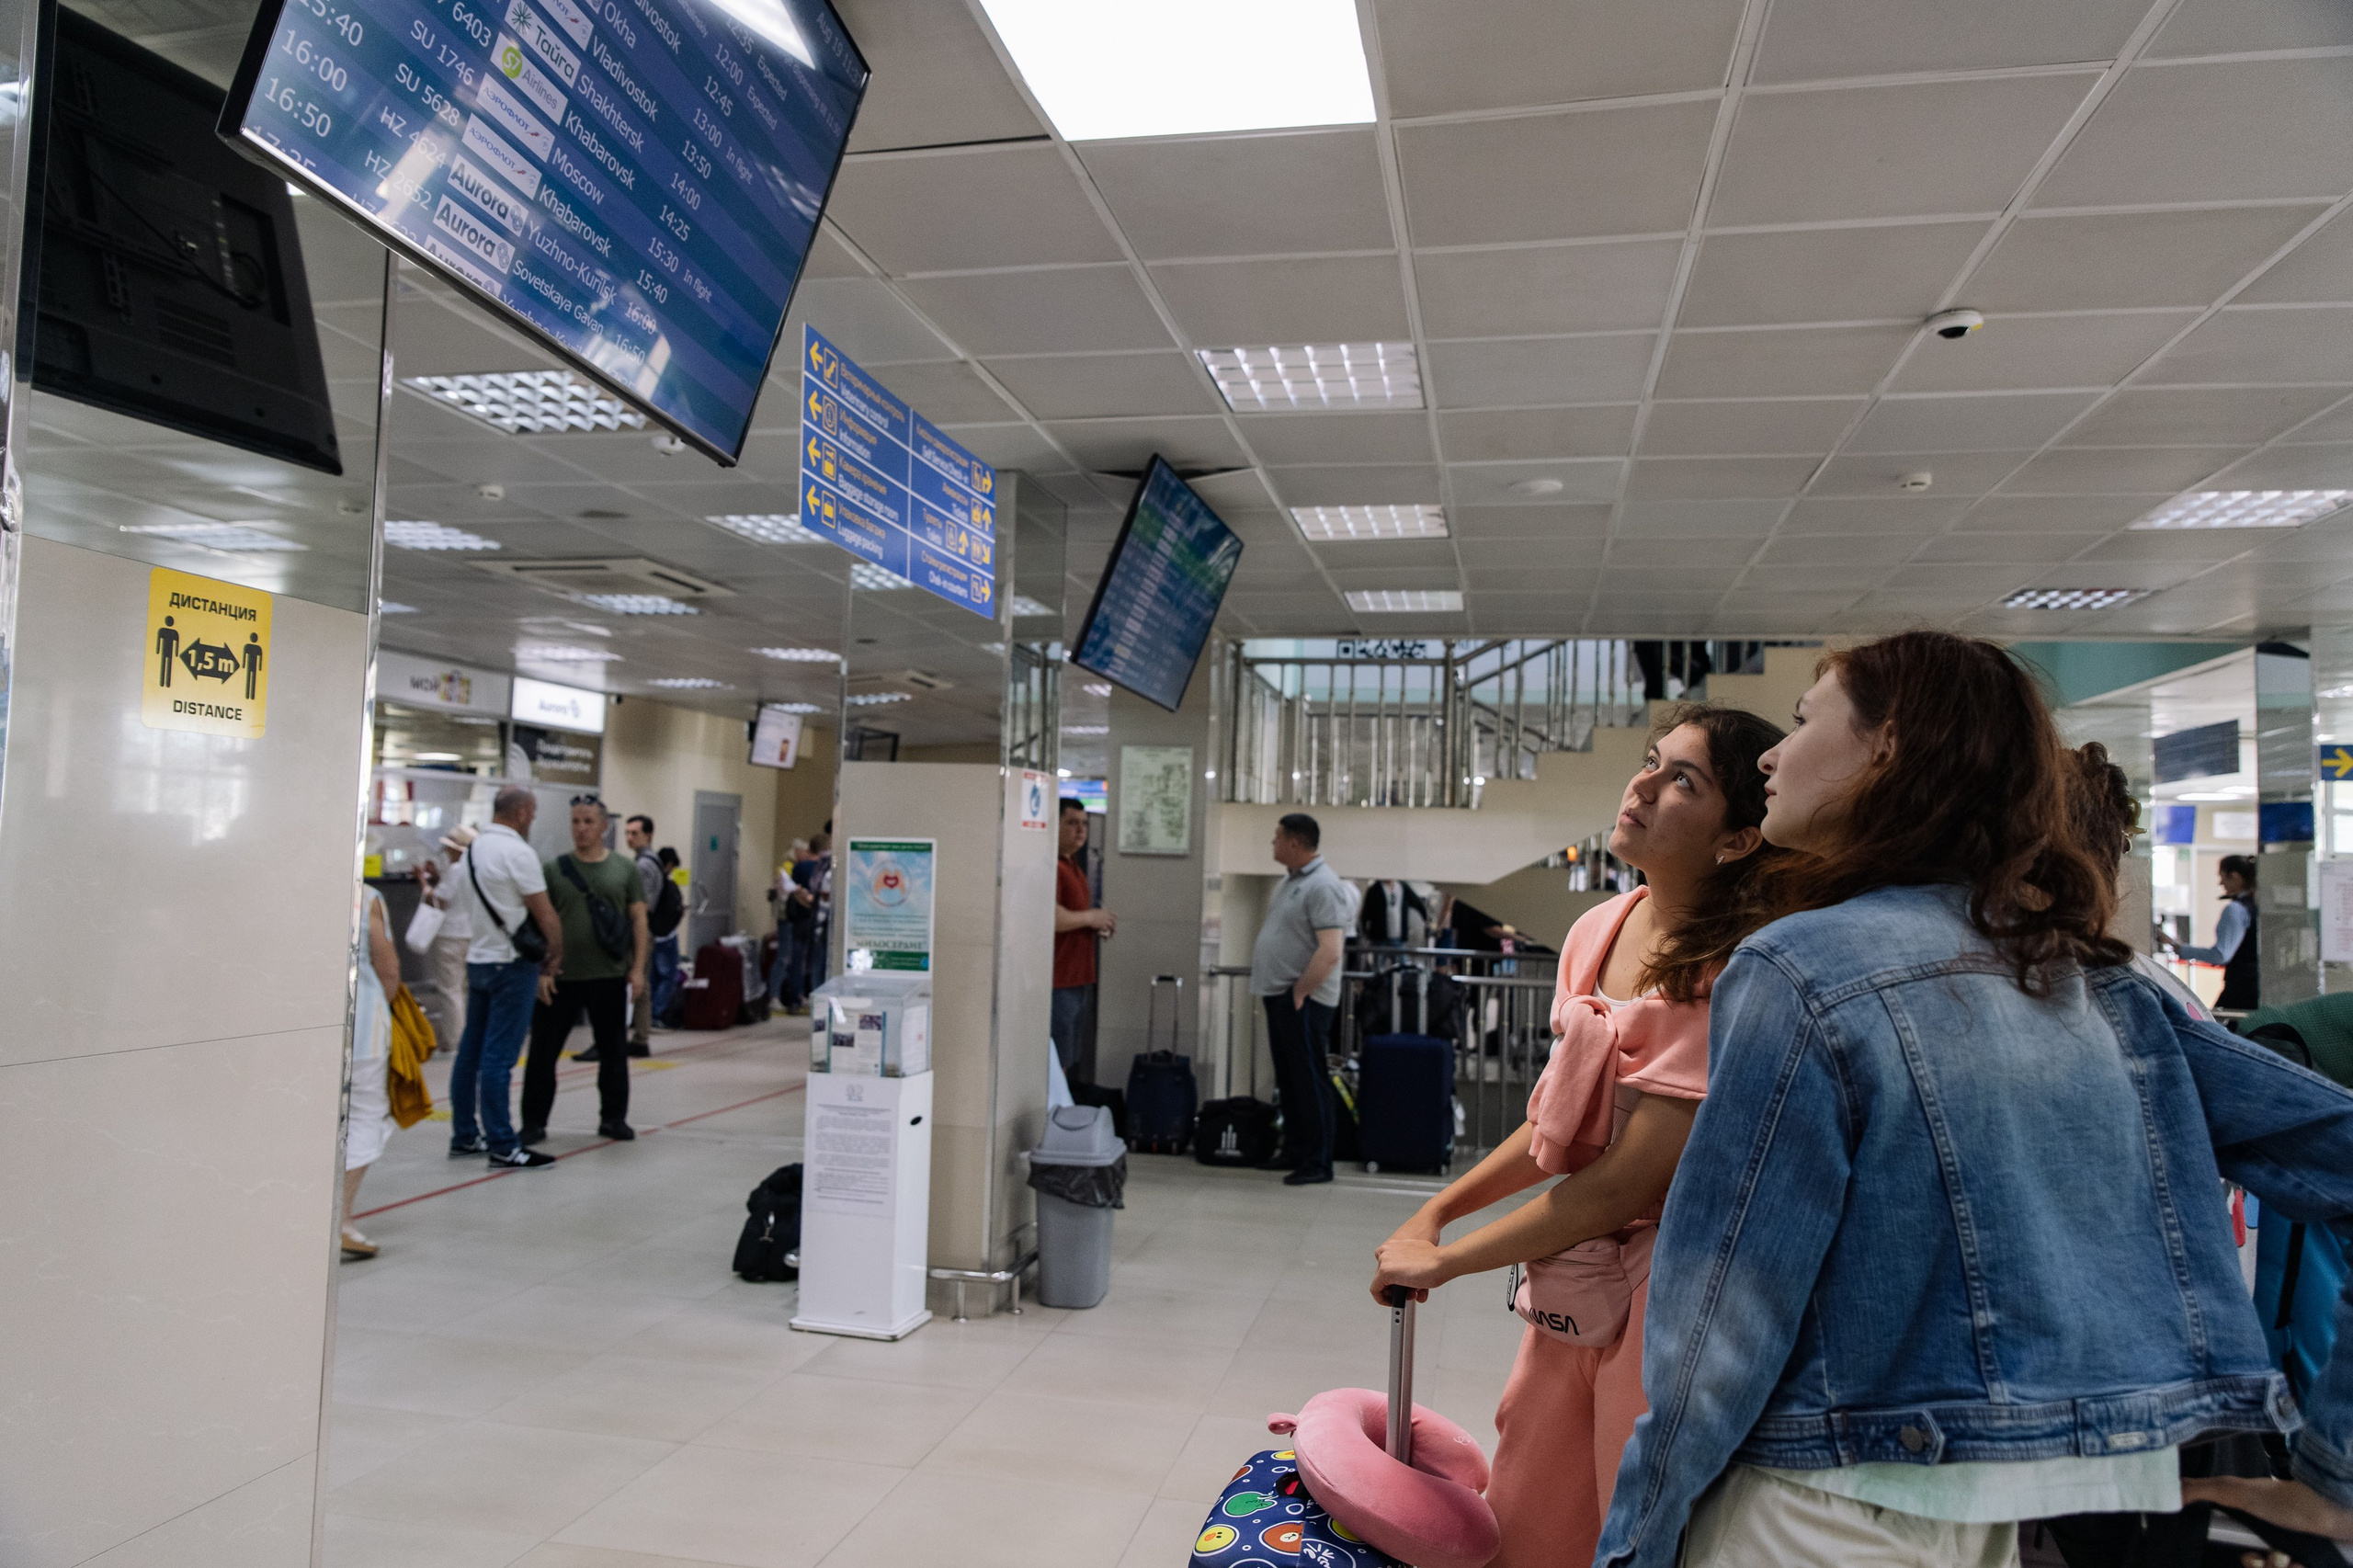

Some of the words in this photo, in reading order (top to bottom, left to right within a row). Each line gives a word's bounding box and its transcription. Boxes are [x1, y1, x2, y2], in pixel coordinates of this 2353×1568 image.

[300, 0, 363, 46] 5:40
[452, 2, 492, 48] 6403
[604, 2, 636, 49] Okha
[281, 28, 347, 92] 16:00
[410, 19, 436, 49] SU
[437, 44, 475, 85] 1746
[715, 43, 744, 85] 12:00
[395, 63, 420, 92] SU
[422, 85, 460, 126] 5628
[503, 51, 521, 72] S7
[522, 69, 558, 109] Airlines
[592, 35, 659, 122] Vladivostok
[704, 75, 733, 118] 12:45
[757, 55, 788, 101] Expected
[265, 77, 331, 137] 16:50
[483, 86, 530, 131] АЭРОФЛОТ
[577, 74, 644, 153] Shakhtersk
[692, 108, 722, 148] 13:00
[747, 85, 778, 130] Expected
[381, 106, 407, 138] HZ
[409, 131, 447, 168] 4624
[468, 127, 516, 169] АЭРОФЛОТ
[565, 110, 636, 191] Khabarovsk
[681, 140, 711, 180] 13:50
[365, 150, 392, 179] HZ
[392, 171, 432, 210] 2652
[449, 163, 509, 221] Aurora
[551, 147, 605, 205] Moscow
[670, 172, 701, 211] 14:00
[436, 202, 496, 258] Aurora
[539, 184, 612, 258] Khabarovsk
[659, 204, 691, 242] 14:25
[528, 221, 618, 305] Yuzhno-Kurilsk
[647, 237, 679, 273] 15:30
[512, 259, 572, 312] Sovetskaya
[574, 304, 604, 335] Gavan
[636, 269, 668, 304] 15:40
[683, 269, 693, 284] In
[692, 278, 713, 303] flight
[624, 301, 657, 335] 16:00
[614, 333, 646, 366] 16:50
[169, 592, 256, 621] ДИСТАНЦИЯ
[188, 649, 215, 672] 1,5
[217, 656, 234, 674] m
[173, 699, 242, 721] DISTANCE
[1529, 1306, 1580, 1335] NASA
